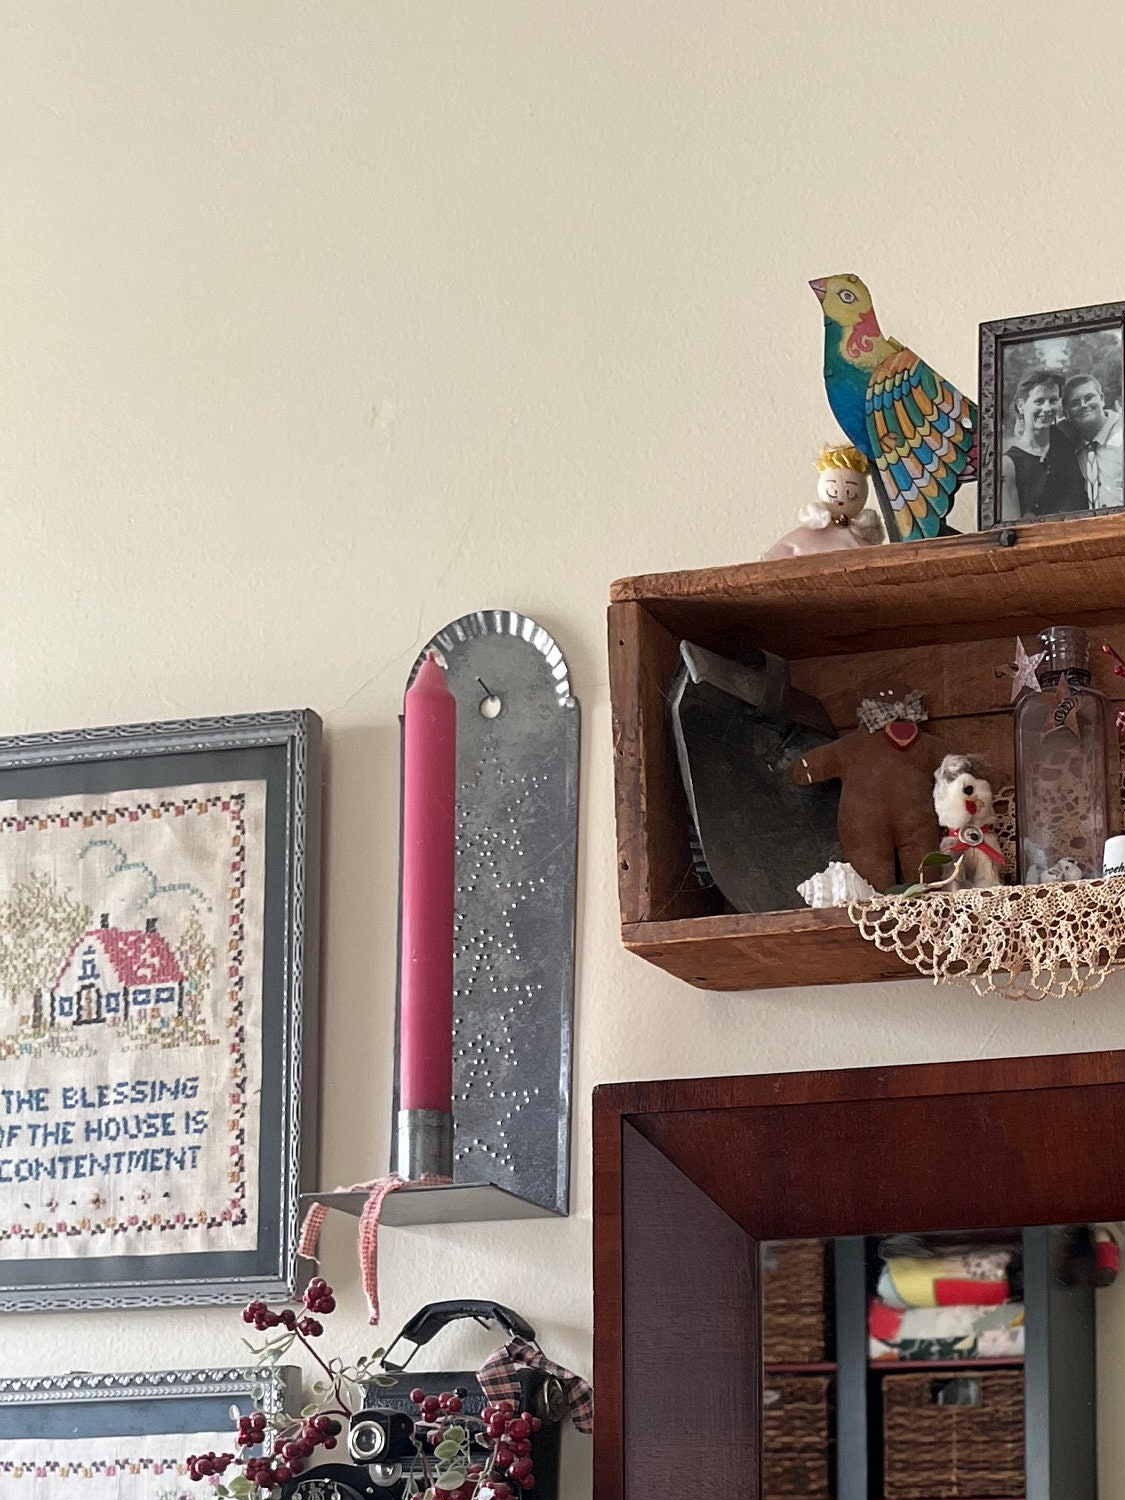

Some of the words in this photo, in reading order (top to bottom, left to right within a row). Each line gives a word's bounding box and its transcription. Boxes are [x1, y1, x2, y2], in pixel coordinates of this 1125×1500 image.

[1, 1087, 49, 1114] THE
[62, 1076, 199, 1109] BLESSING
[0, 1124, 22, 1148] F
[28, 1121, 75, 1147] THE
[85, 1111, 176, 1142] HOUSE
[185, 1110, 208, 1135] IS
[0, 1145, 201, 1182] CONTENTMENT
